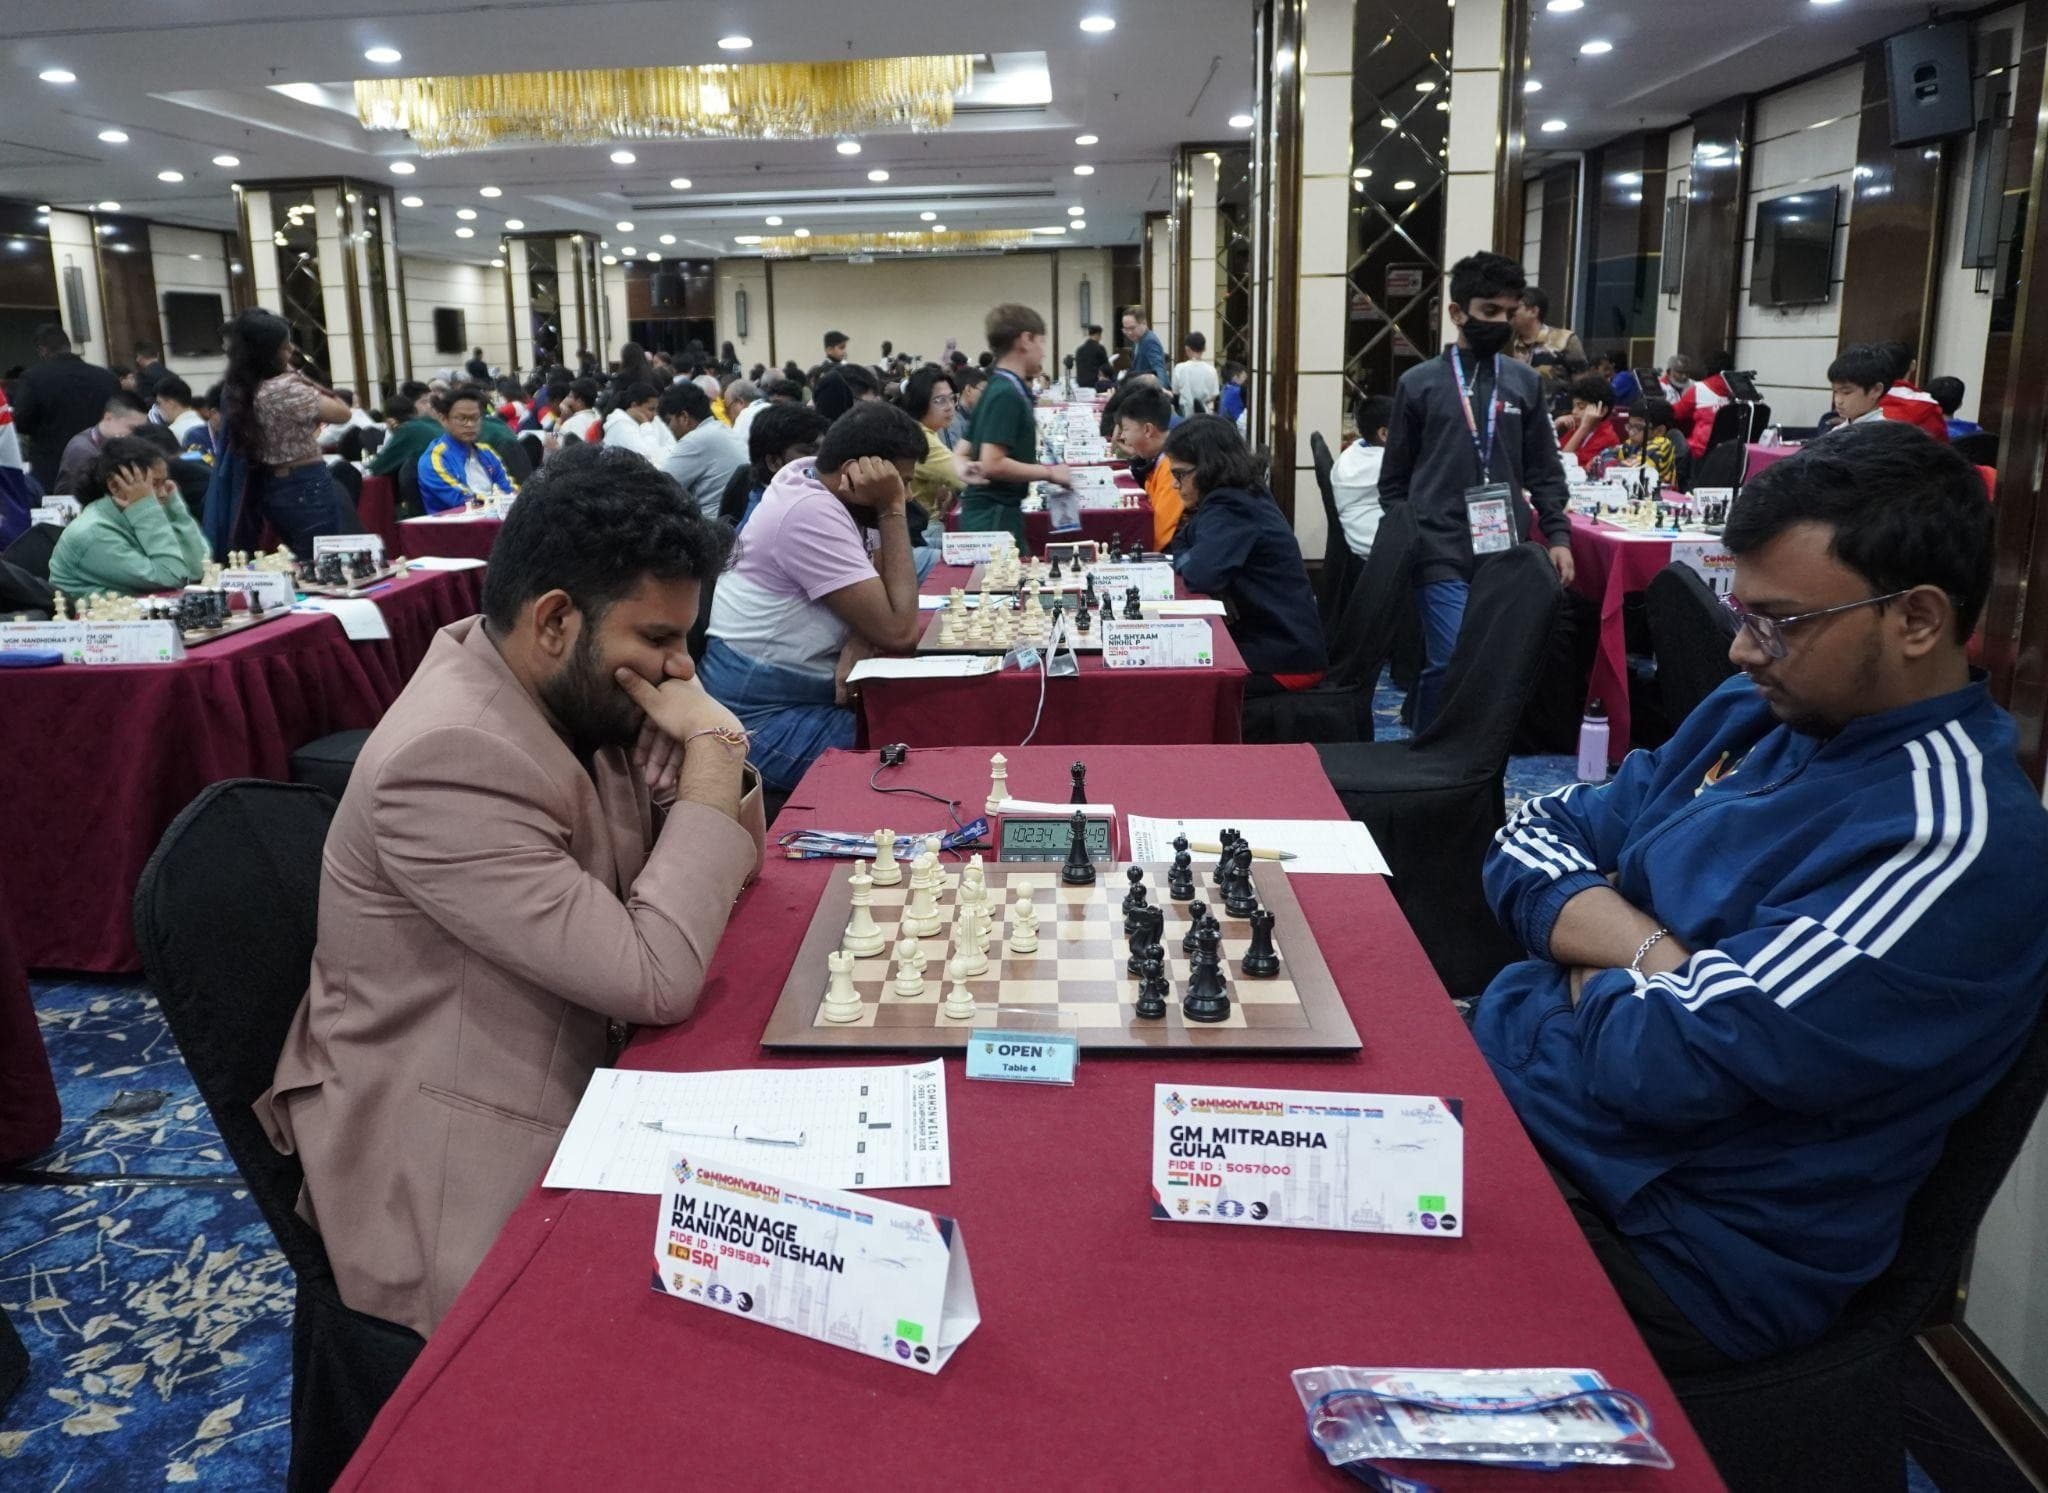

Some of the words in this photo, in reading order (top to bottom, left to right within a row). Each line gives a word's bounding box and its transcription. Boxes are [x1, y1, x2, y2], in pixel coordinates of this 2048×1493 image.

[998, 1044, 1043, 1058] OPEN
[1002, 1063, 1028, 1072] Table
[1030, 1063, 1036, 1073] 4
[1190, 1097, 1284, 1112] COMMONWEALTH
[926, 1083, 940, 1151] COMMONWEALTH
[1169, 1125, 1202, 1142] GM
[1212, 1127, 1328, 1149] MITRABHA
[1169, 1142, 1226, 1160] GUHA
[1168, 1160, 1195, 1171] FIDE
[1200, 1161, 1213, 1171] ID
[1226, 1163, 1291, 1176] 5057000
[696, 1168, 781, 1198] COMMONWEALTH
[1189, 1173, 1223, 1188] IND
[673, 1193, 696, 1216] IM
[702, 1201, 798, 1243] LIYANAGE
[669, 1230, 695, 1246] FIDE
[696, 1236, 709, 1250] ID
[719, 1244, 771, 1268] 9915834
[670, 1210, 755, 1249] RANINDU
[761, 1235, 845, 1274] DILSHAN
[691, 1249, 718, 1271] SRI
